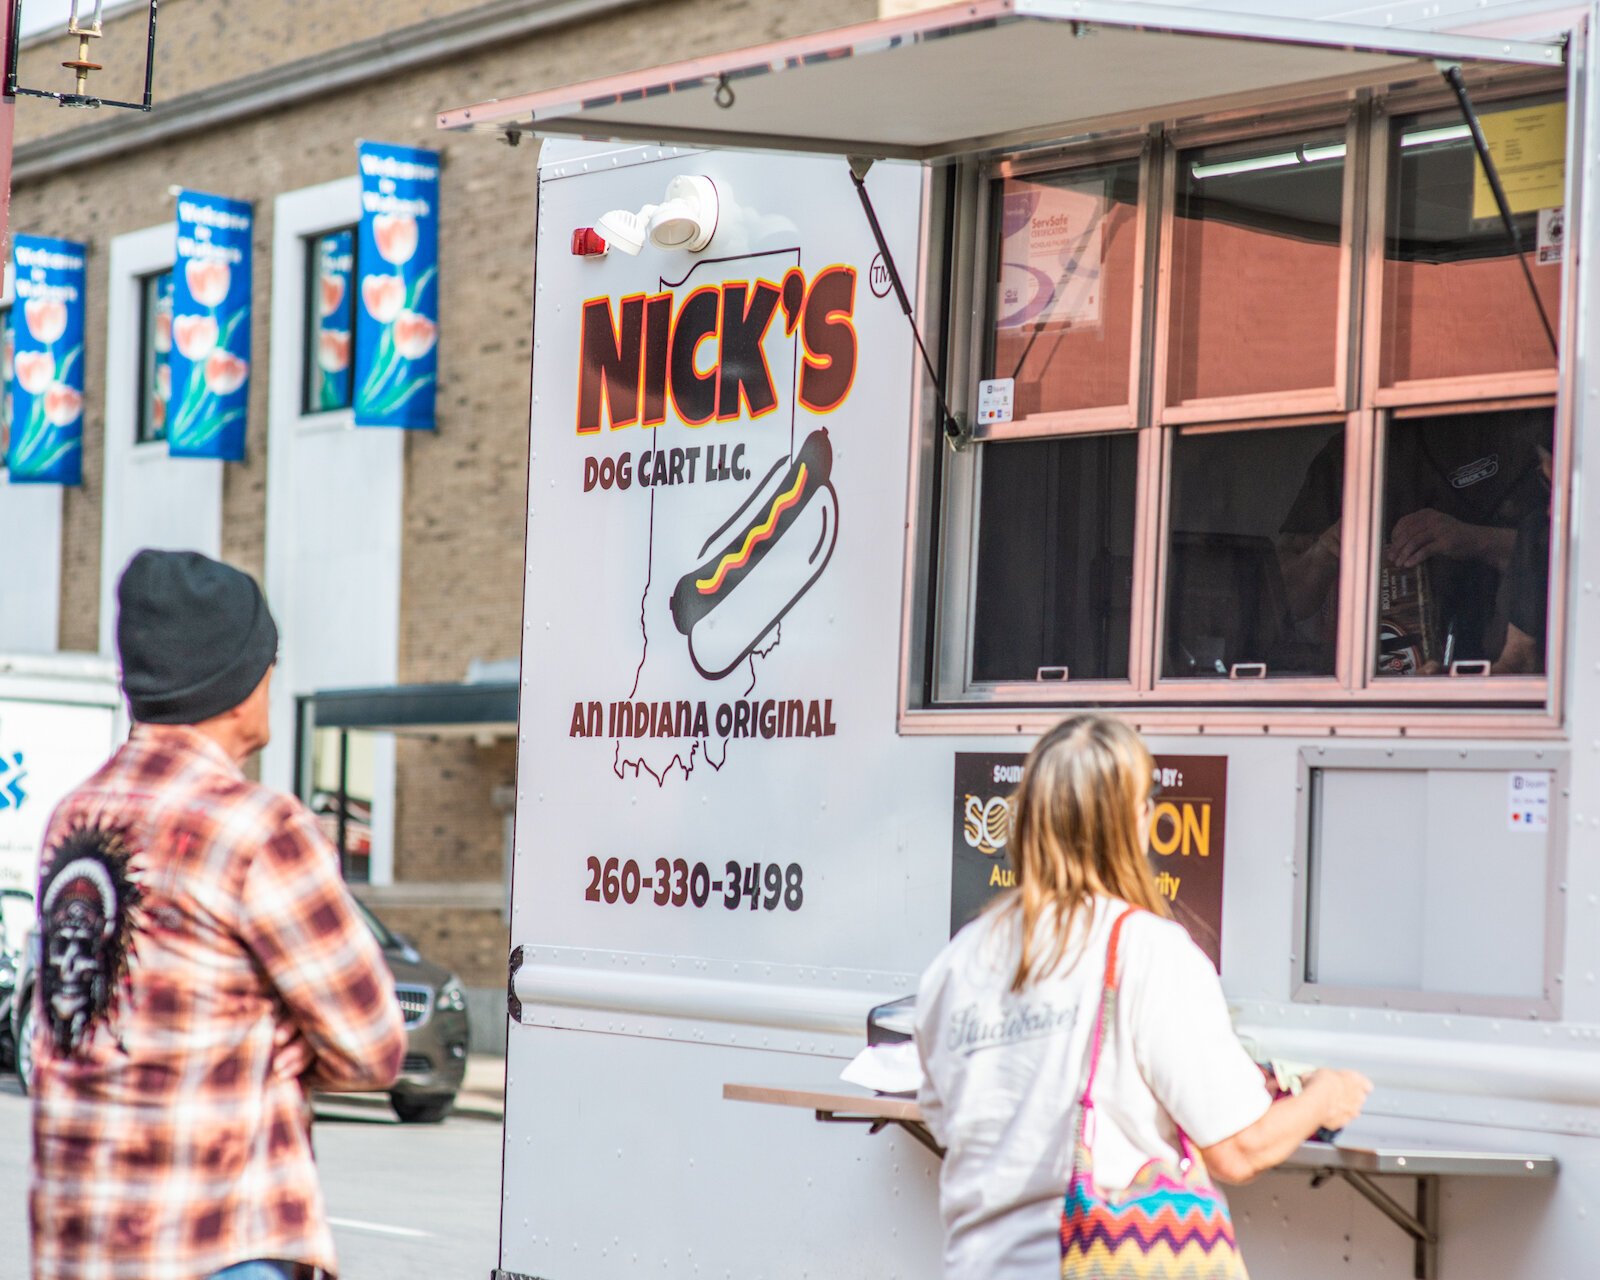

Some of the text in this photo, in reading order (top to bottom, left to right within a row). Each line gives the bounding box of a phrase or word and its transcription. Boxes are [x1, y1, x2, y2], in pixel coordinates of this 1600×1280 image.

[1031, 213, 1068, 229] ServSafe
[575, 264, 858, 436] NICK'S
[584, 443, 751, 492] DOG CART LLC.
[569, 699, 836, 740] AN INDIANA ORIGINAL
[993, 765, 1025, 784] SOUN
[1150, 801, 1211, 857] ON
[585, 855, 804, 912] 260-330-3498
